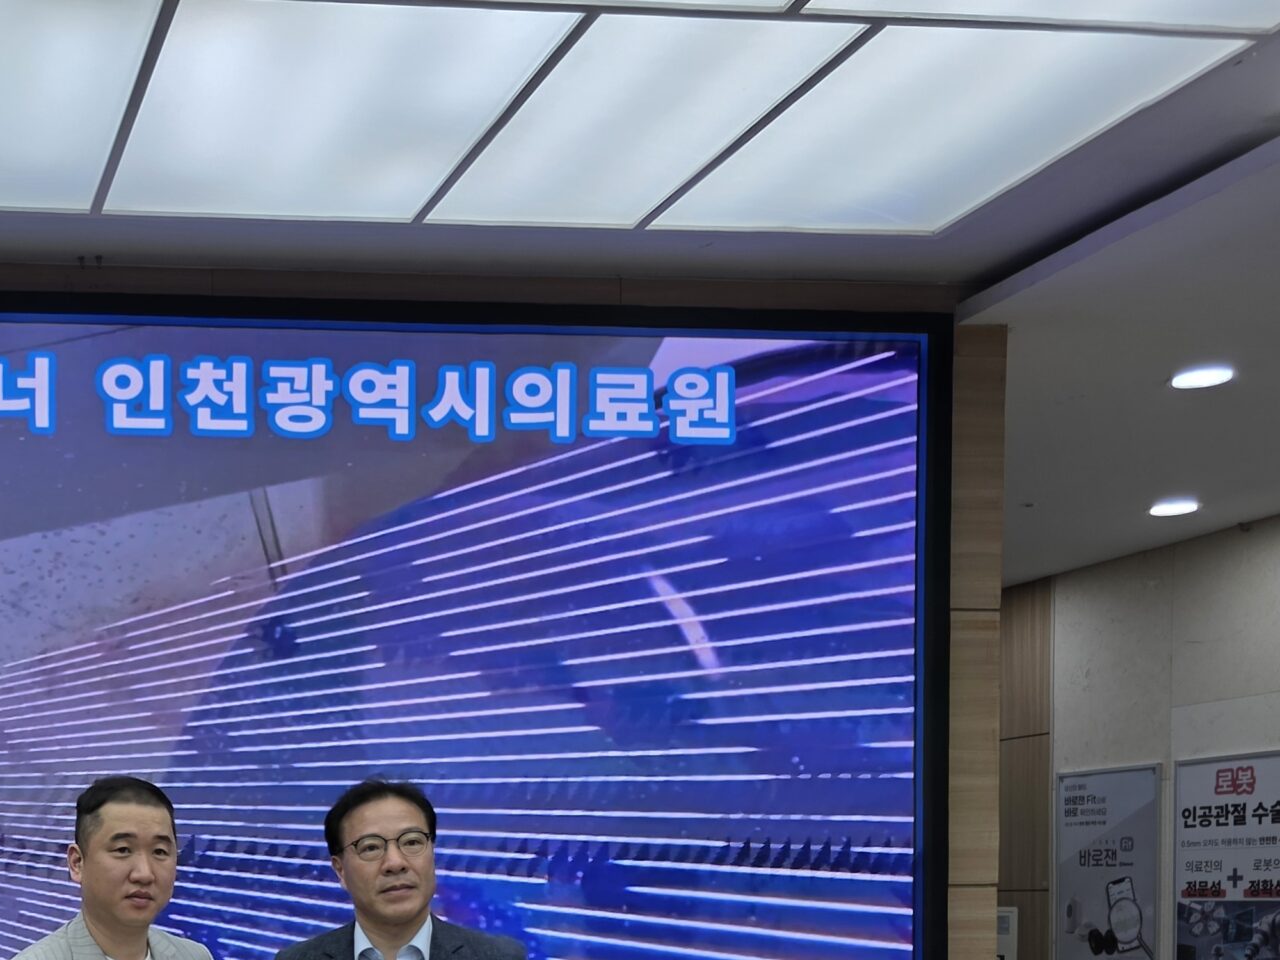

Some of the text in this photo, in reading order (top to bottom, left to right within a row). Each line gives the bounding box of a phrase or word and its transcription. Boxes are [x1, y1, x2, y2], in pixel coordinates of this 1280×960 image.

[102, 360, 732, 439] 인천광역시의료원
[1215, 767, 1255, 796] 로봇
[1182, 804, 1247, 829] 인공관절
[1185, 860, 1222, 873] 의료진의
